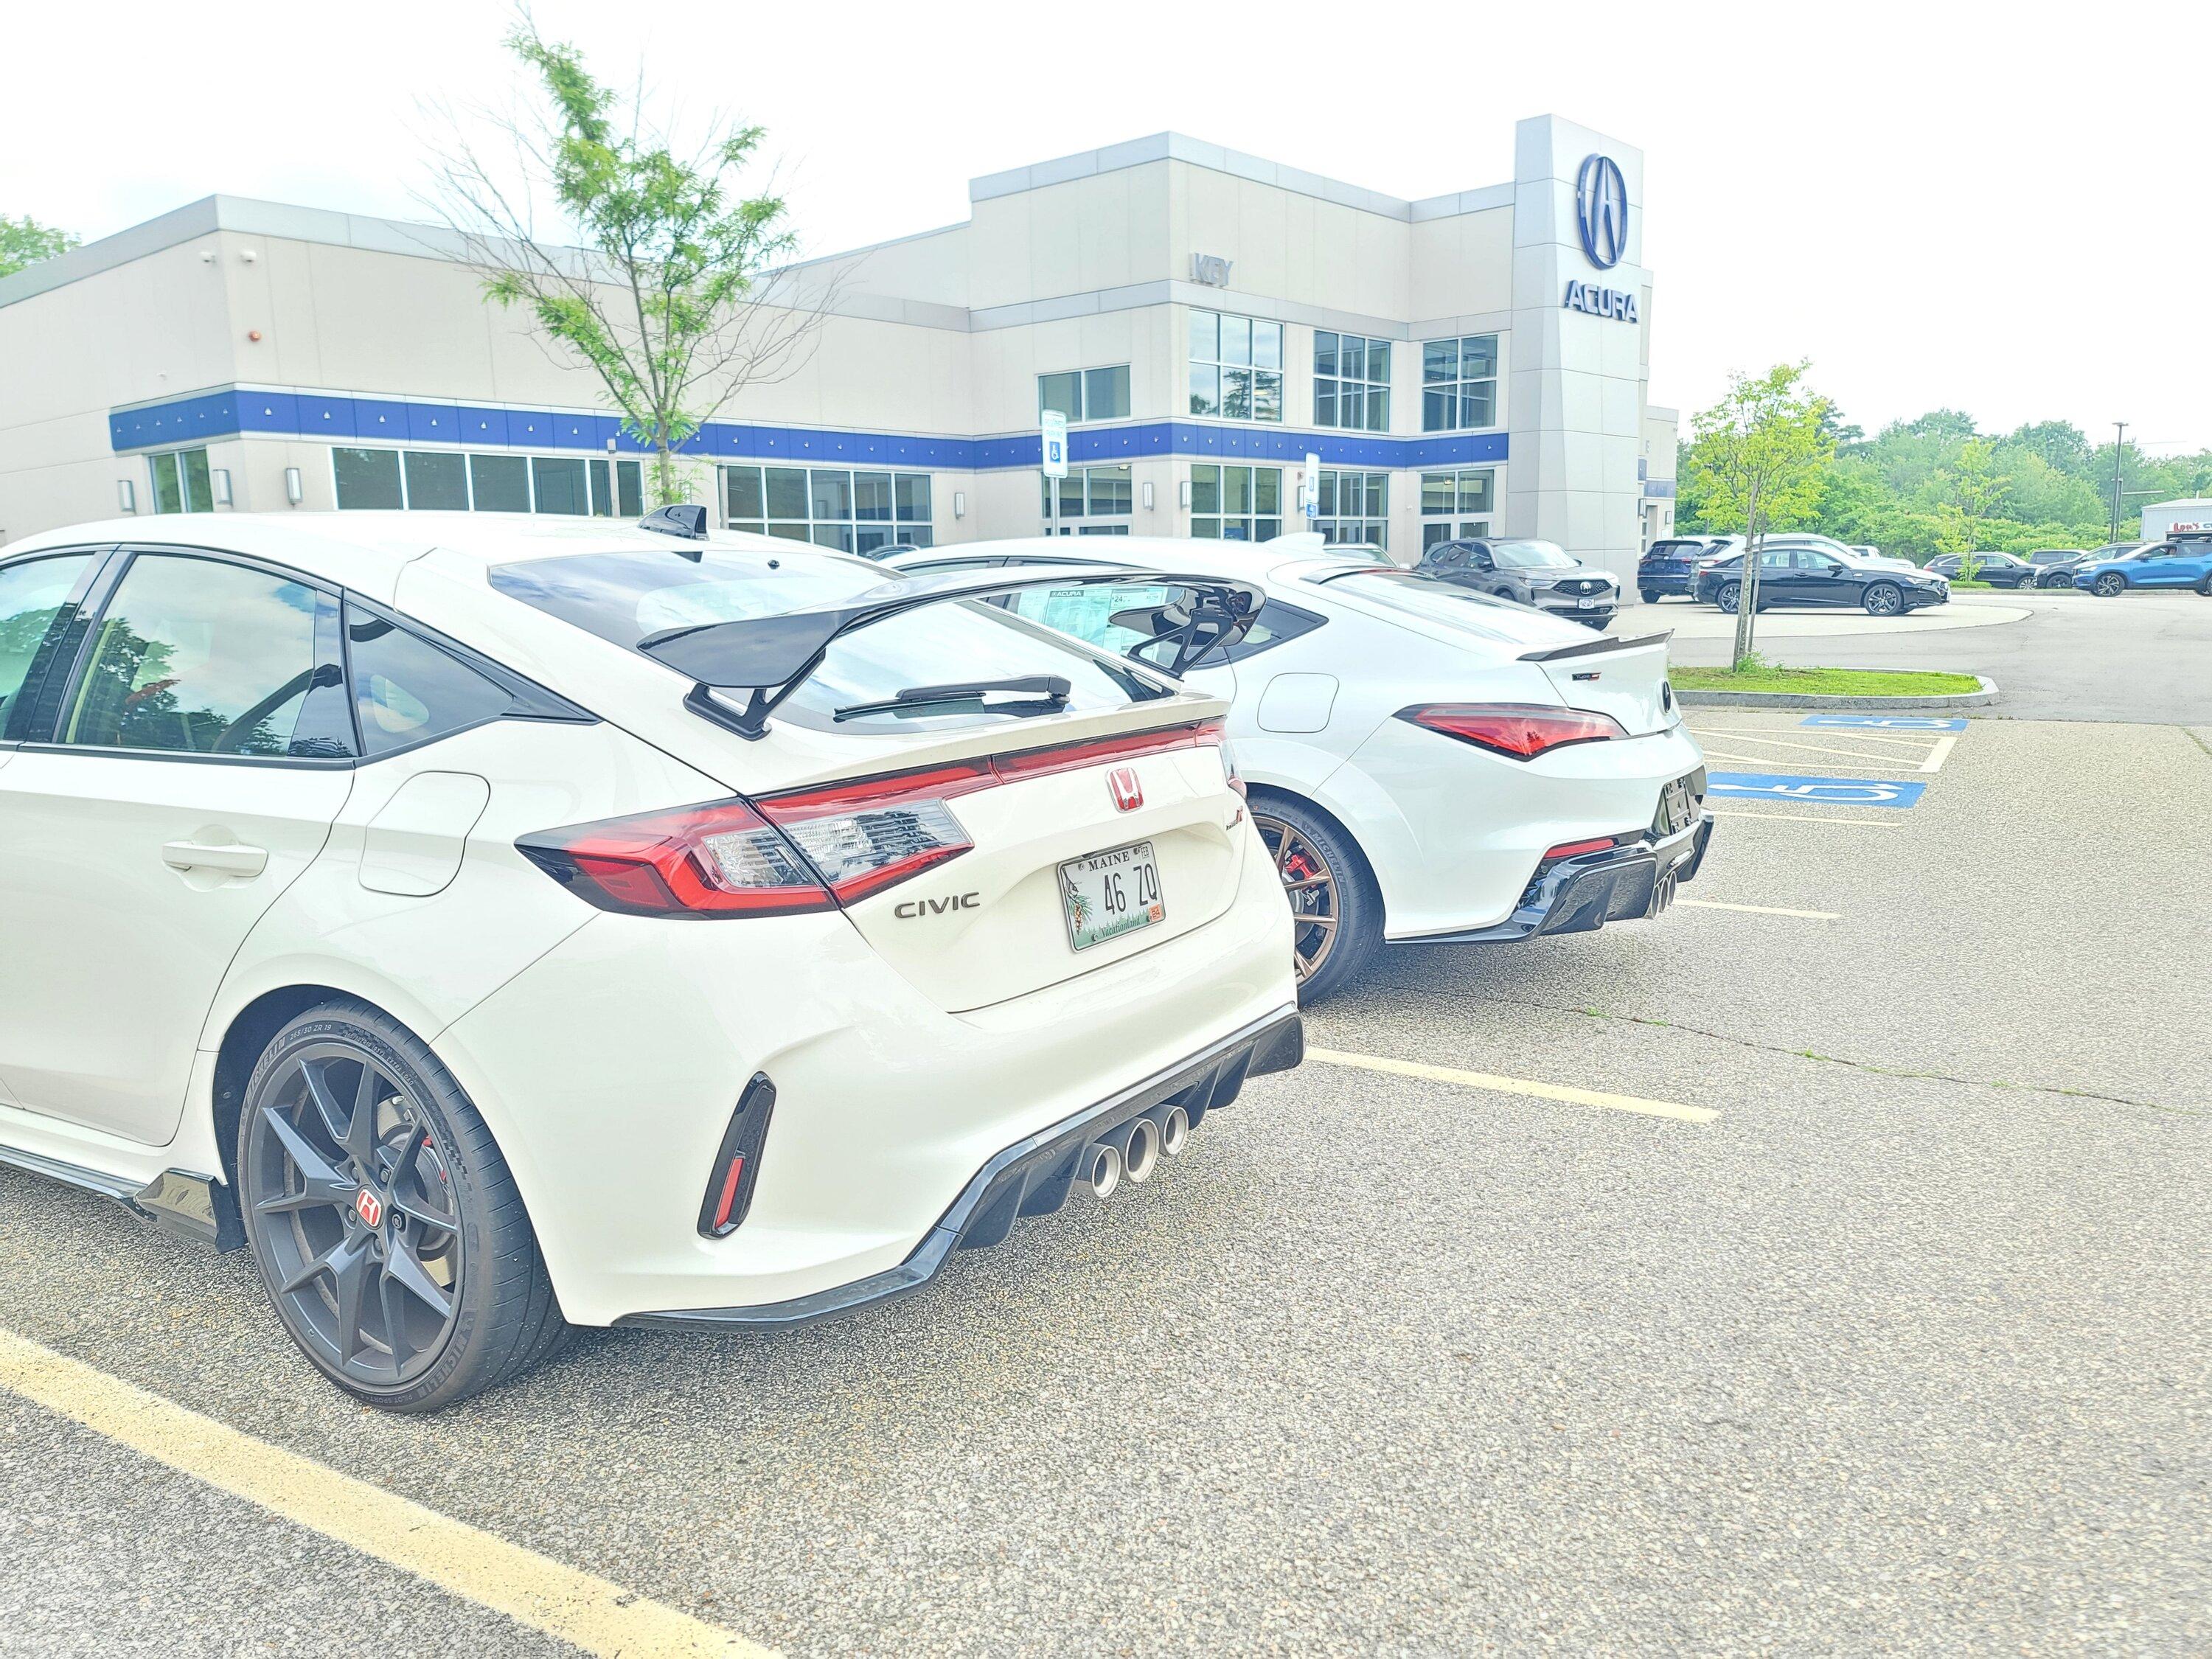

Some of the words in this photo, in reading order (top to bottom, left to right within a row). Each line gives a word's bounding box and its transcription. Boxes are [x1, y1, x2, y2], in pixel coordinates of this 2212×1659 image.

[1193, 252, 1234, 288] KEY
[1564, 279, 1639, 324] ACURA
[1088, 851, 1130, 872] MAINE
[1312, 832, 1345, 883] MICHELIN
[894, 891, 980, 919] CIVIC
[1105, 872, 1126, 915] 46
[1133, 863, 1157, 906] ZQ
[1101, 915, 1140, 937] Vacationland
[246, 1036, 286, 1105] MICHELIN
[386, 1056, 402, 1072] EXTRA
[401, 1070, 414, 1085] LOAD
[417, 1333, 467, 1398] MICHELIN
